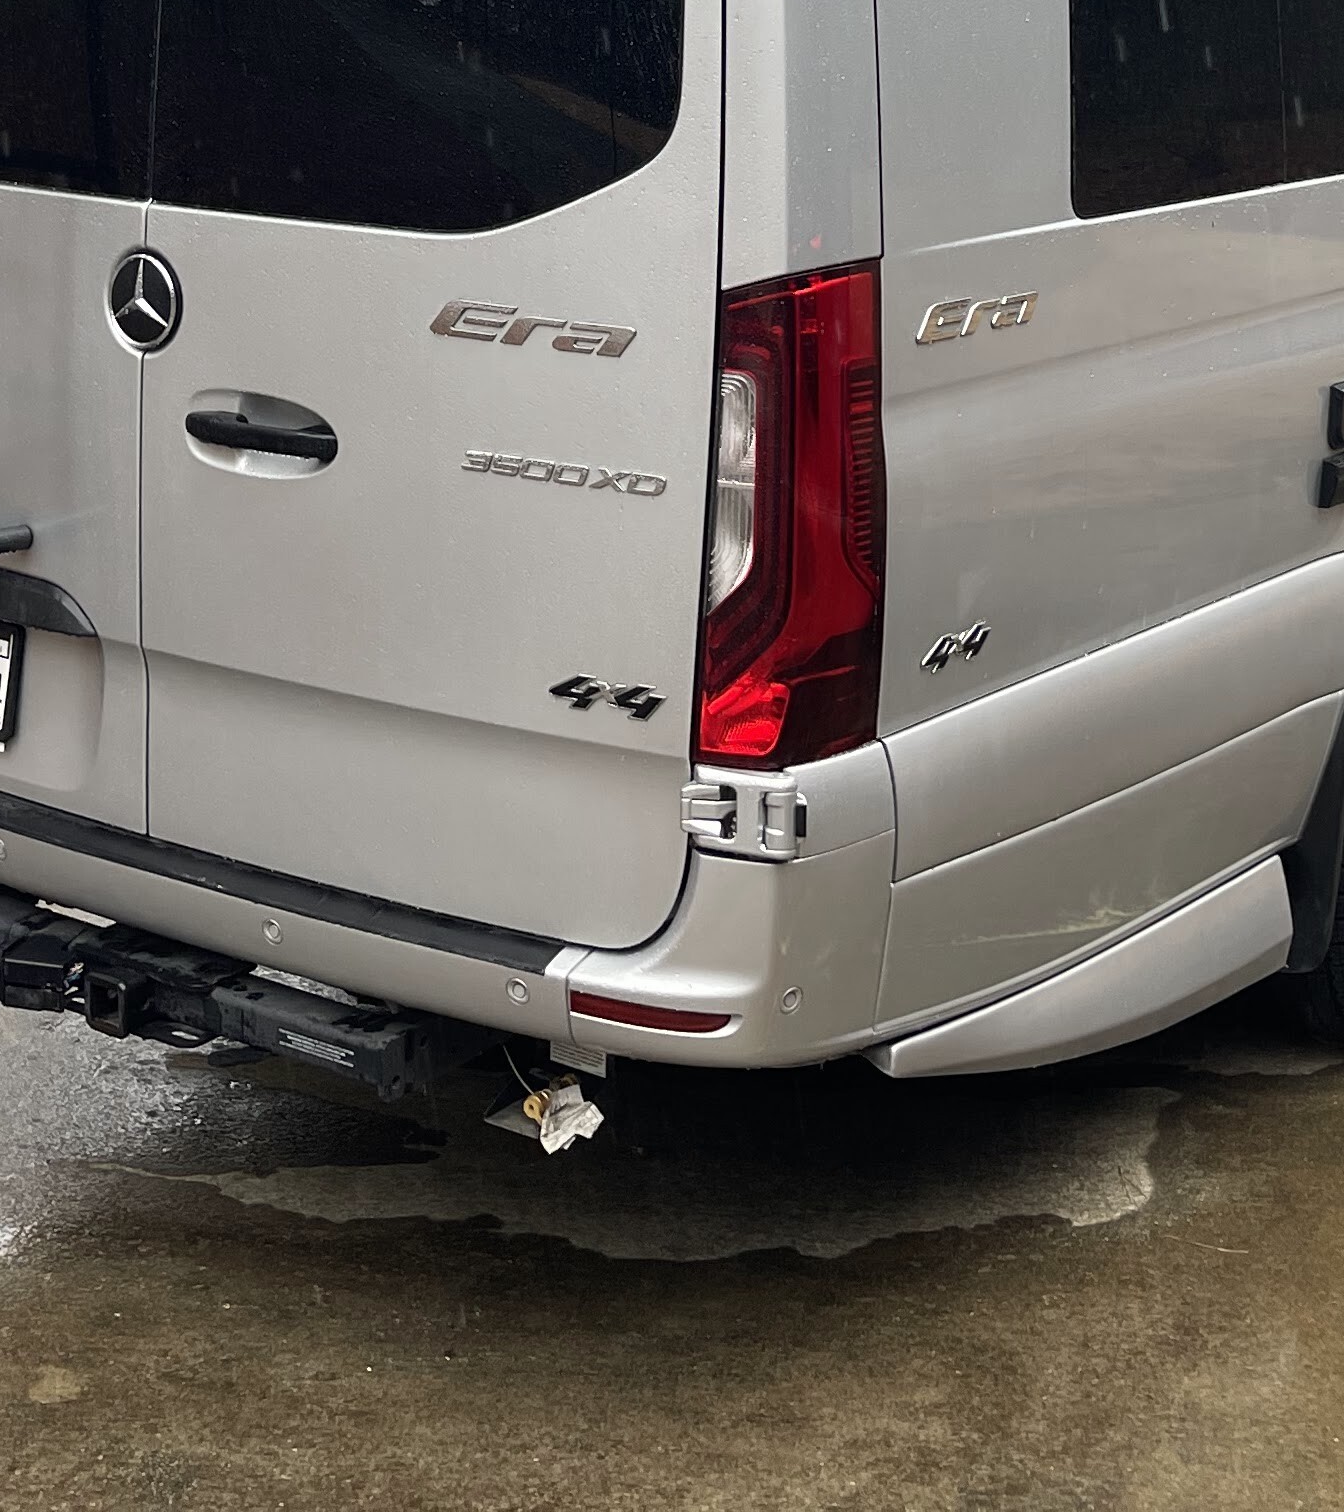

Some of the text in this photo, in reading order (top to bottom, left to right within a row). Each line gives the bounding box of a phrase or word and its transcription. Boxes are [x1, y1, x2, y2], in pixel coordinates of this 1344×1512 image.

[429, 297, 638, 358] Era
[915, 290, 1039, 345] Era
[549, 672, 669, 722] 4x4
